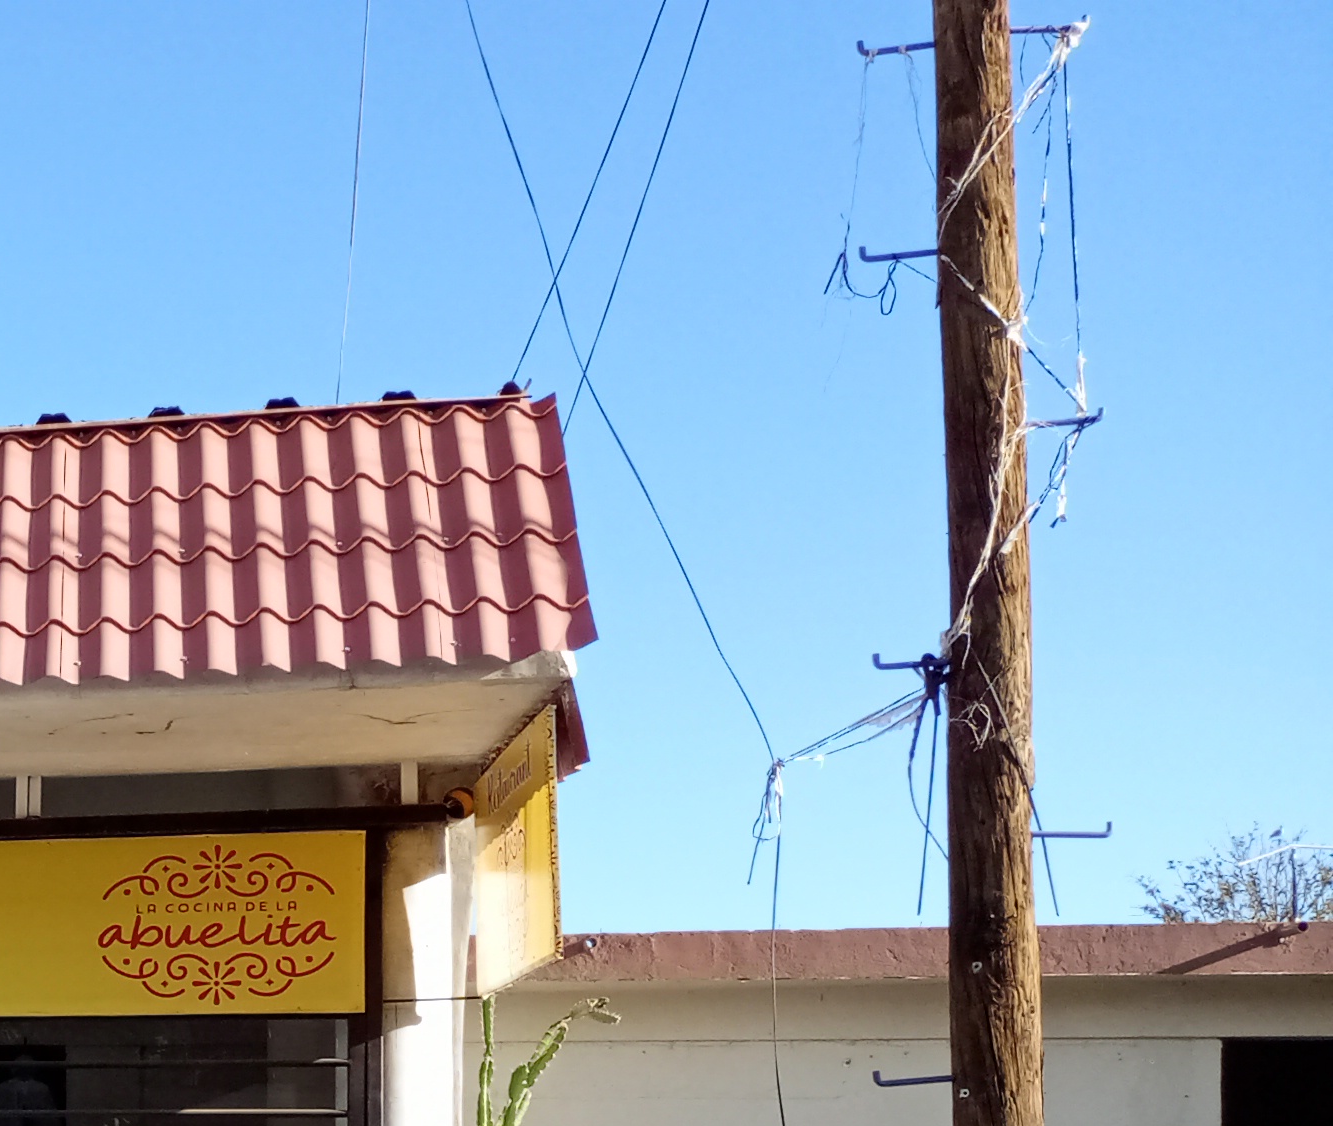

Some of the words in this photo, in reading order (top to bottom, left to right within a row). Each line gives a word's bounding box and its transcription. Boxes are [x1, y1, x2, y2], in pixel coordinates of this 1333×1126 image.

[487, 738, 531, 815] Restaurant
[136, 904, 156, 914] LA
[165, 902, 237, 913] COCINA
[246, 901, 268, 912] DE
[277, 900, 298, 911] LA
[98, 914, 337, 950] abuelita
